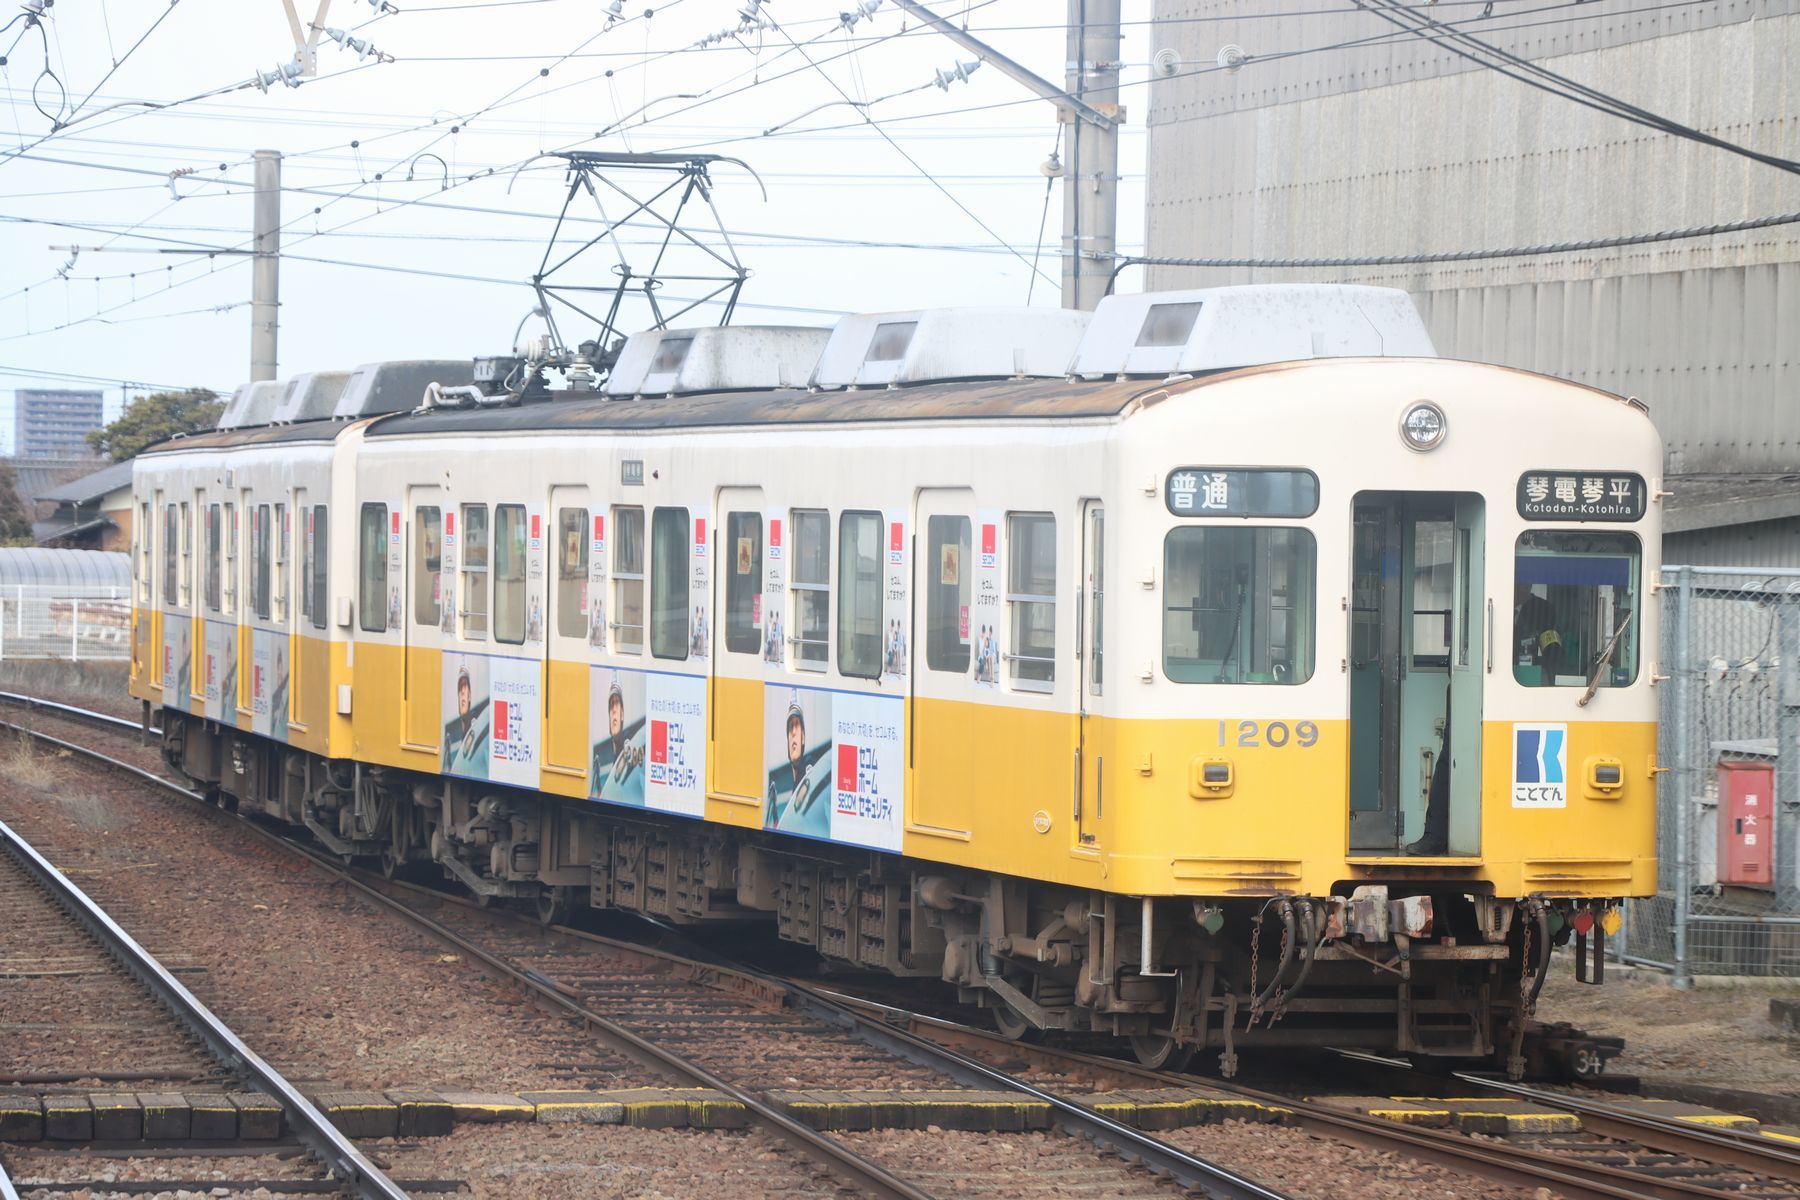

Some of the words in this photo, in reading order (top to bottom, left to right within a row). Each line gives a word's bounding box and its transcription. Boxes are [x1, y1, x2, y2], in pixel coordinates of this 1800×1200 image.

[1171, 472, 1228, 509] 普通
[1526, 476, 1632, 504] 琴電琴平
[1525, 503, 1632, 514] Kotoden-Kotohira
[509, 703, 522, 721] セコム
[509, 722, 522, 742] ホーム
[669, 722, 684, 744] セコム
[1218, 720, 1319, 748] 1209
[494, 740, 507, 755] SECOM
[509, 743, 533, 763] セキュリティ
[668, 744, 684, 766] ホーム
[859, 747, 878, 770] セコム
[651, 765, 666, 780] SECOM
[668, 766, 697, 790] セキュリティ
[859, 771, 878, 795] ホーム
[838, 792, 857, 811] SECOM
[1516, 787, 1563, 801] ことでん
[859, 795, 892, 820] セキュリティ
[1576, 1049, 1601, 1075] 34
